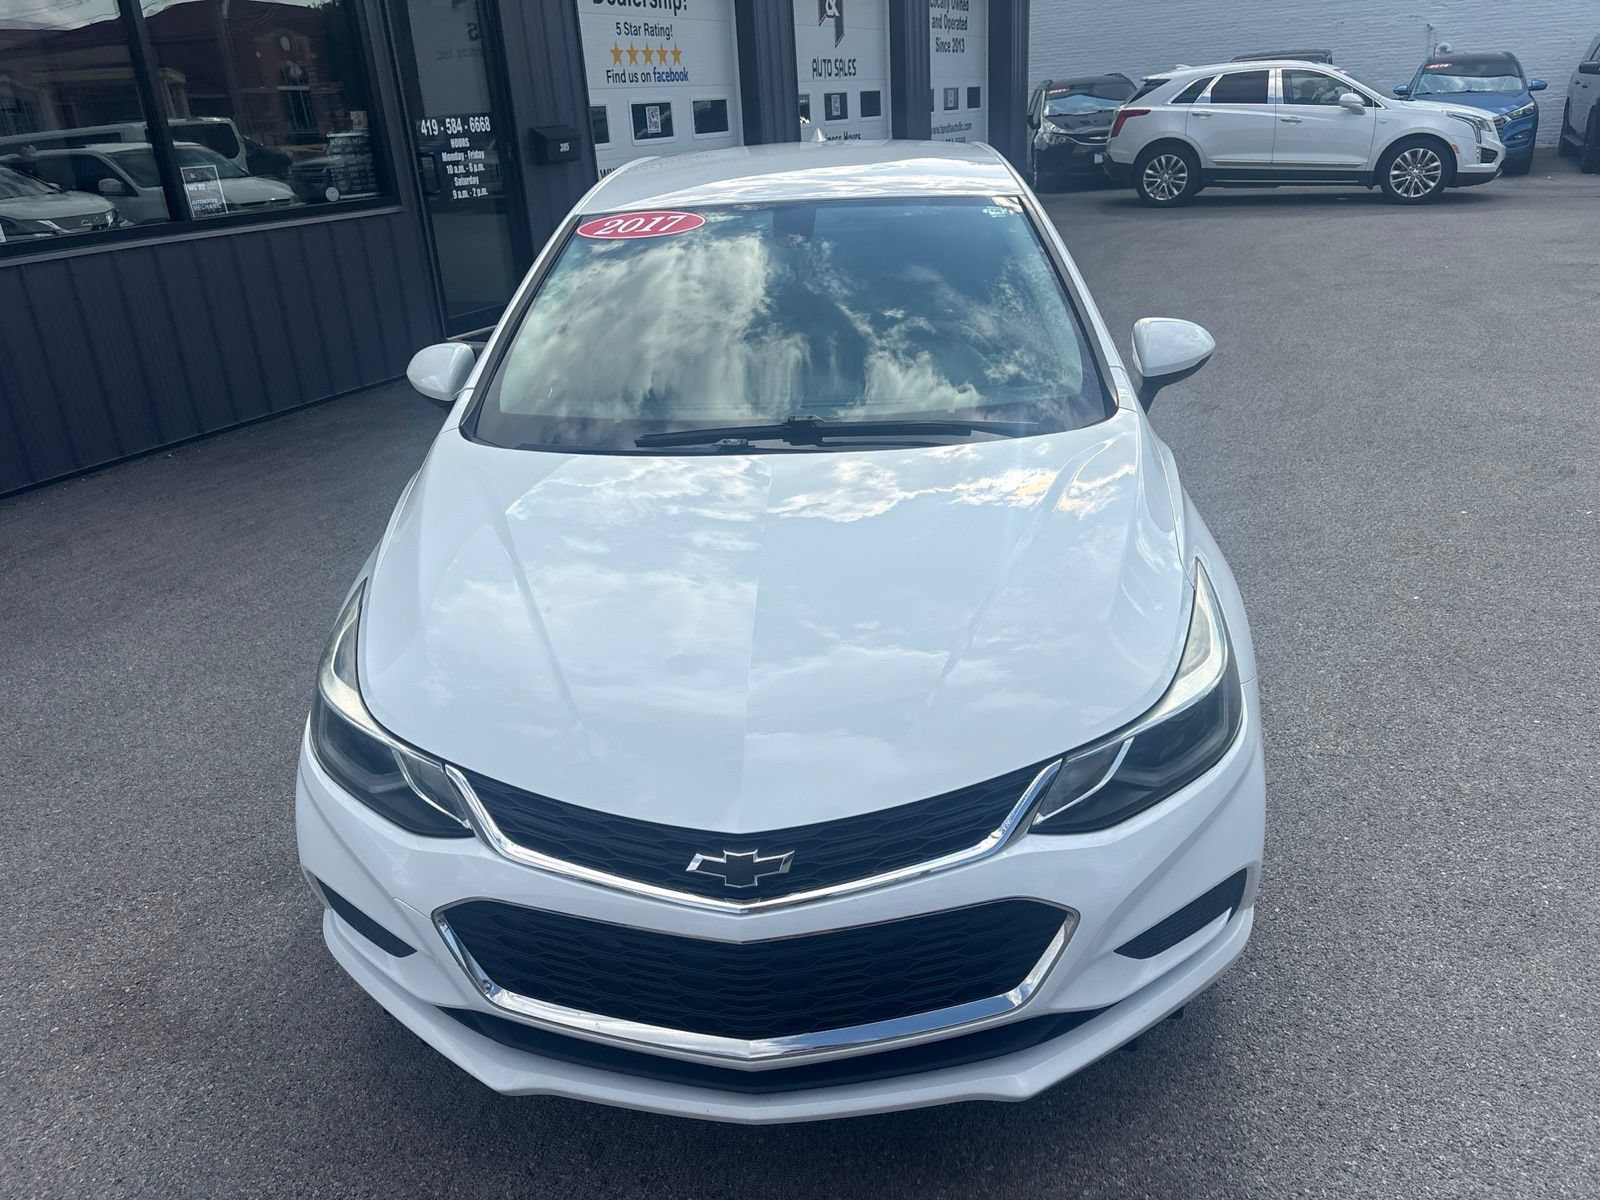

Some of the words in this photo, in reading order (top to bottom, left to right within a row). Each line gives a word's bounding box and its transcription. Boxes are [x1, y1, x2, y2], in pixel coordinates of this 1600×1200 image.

[616, 22, 621, 36] 5
[623, 22, 641, 36] Star
[643, 23, 673, 40] Rating!
[932, 14, 942, 28] and
[944, 14, 968, 33] Operated
[936, 36, 951, 52] Since
[952, 37, 965, 53] 2013
[606, 69, 626, 84] Find
[628, 72, 641, 83] us
[641, 71, 651, 83] on
[653, 67, 689, 82] facebook
[812, 56, 833, 79] AUTO
[834, 58, 857, 78] SALES
[450, 137, 470, 148] HOURS
[441, 152, 465, 162] Monday
[467, 150, 485, 160] Friday
[453, 175, 480, 187] Saturday
[593, 215, 688, 235] 2017
